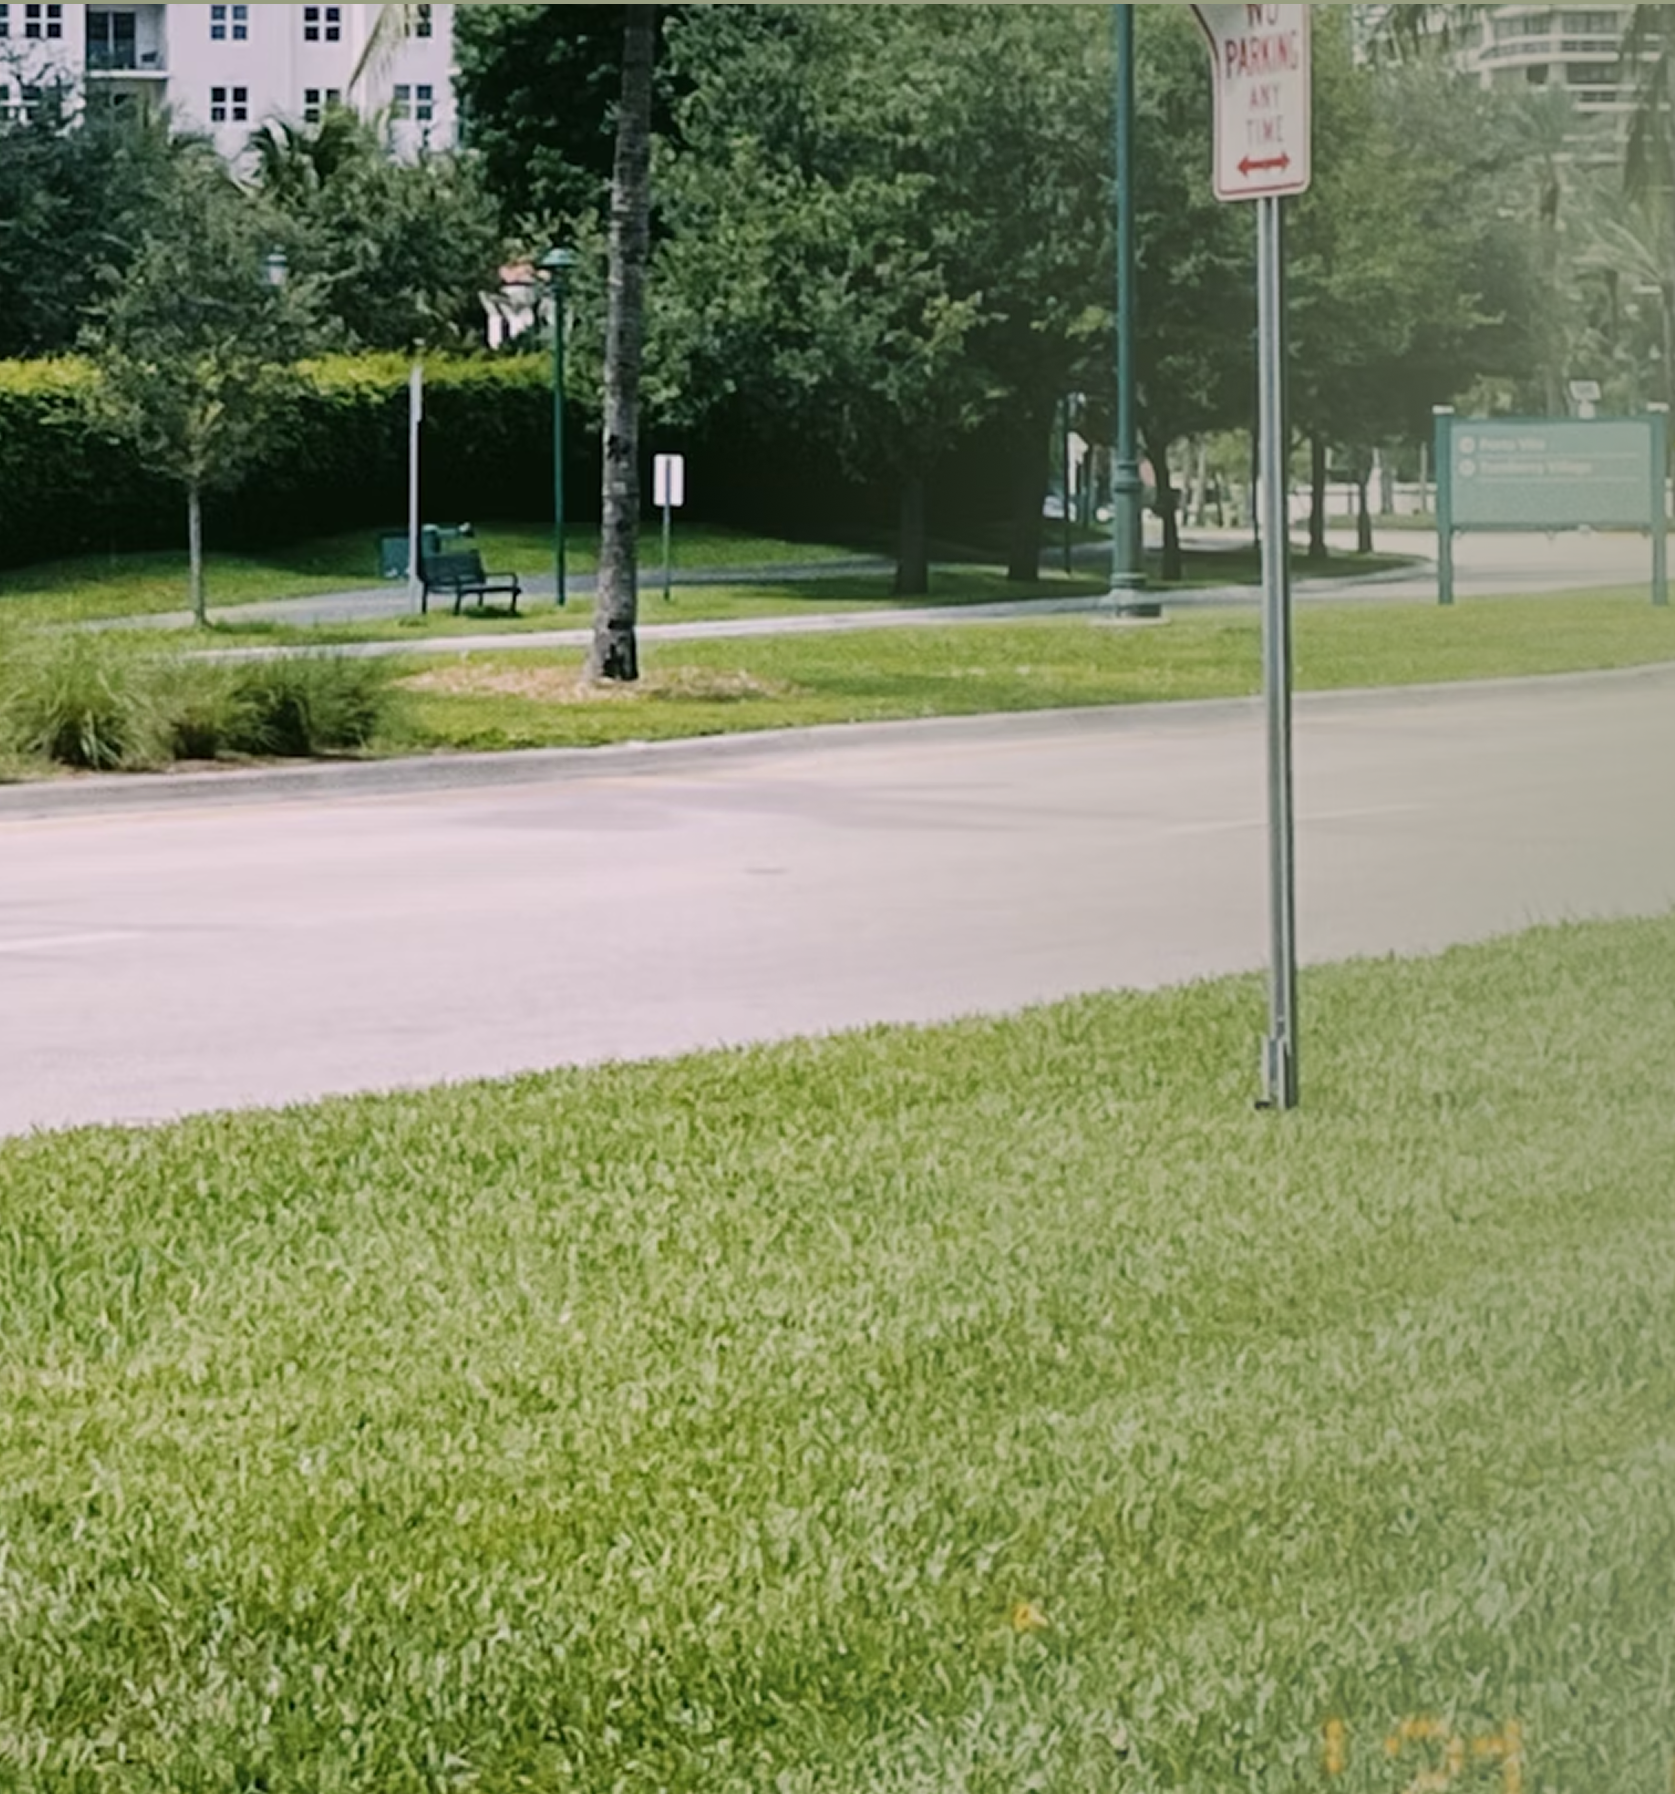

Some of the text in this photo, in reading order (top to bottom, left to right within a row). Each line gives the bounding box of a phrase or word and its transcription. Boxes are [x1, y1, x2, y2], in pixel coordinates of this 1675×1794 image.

[1225, 30, 1298, 79] PARKING
[1249, 83, 1281, 110] ANY
[1246, 115, 1283, 147] TIME
